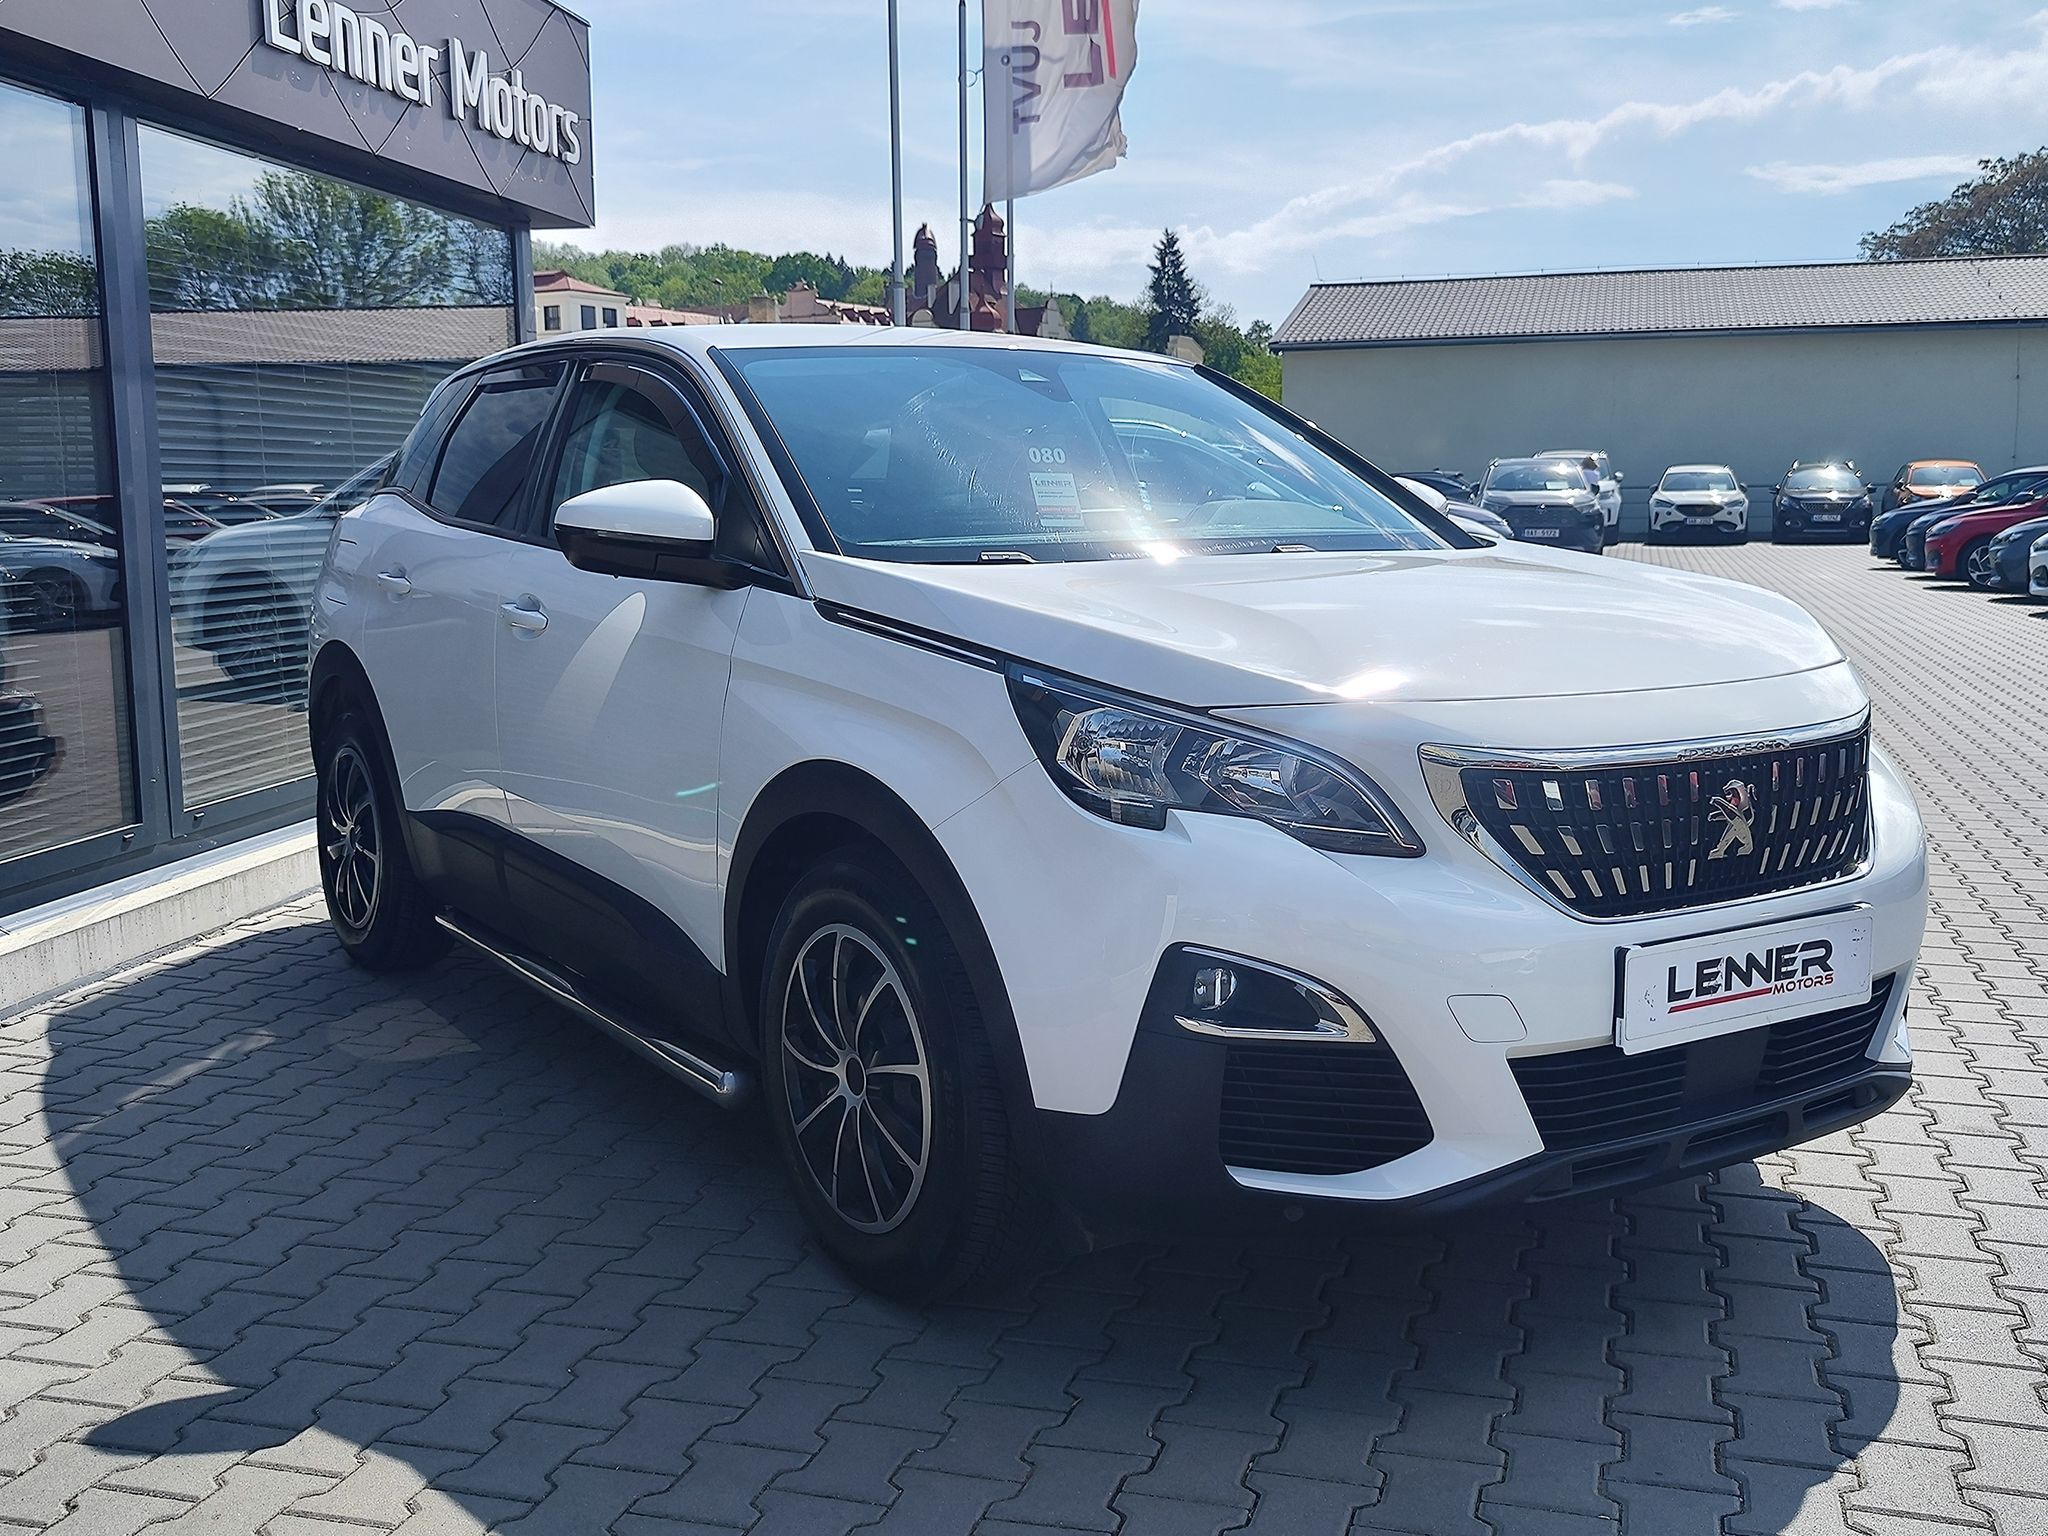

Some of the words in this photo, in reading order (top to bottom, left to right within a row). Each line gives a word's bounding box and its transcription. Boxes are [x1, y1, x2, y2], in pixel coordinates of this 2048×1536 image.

[263, 0, 439, 107] Lenner
[449, 37, 582, 165] Motors
[1001, 20, 1041, 135] TVŮJ
[1028, 447, 1066, 464] 080
[1689, 740, 1778, 757] PEUGEOT
[1667, 939, 1834, 1004] LENNER
[1772, 973, 1835, 995] MOTORS
